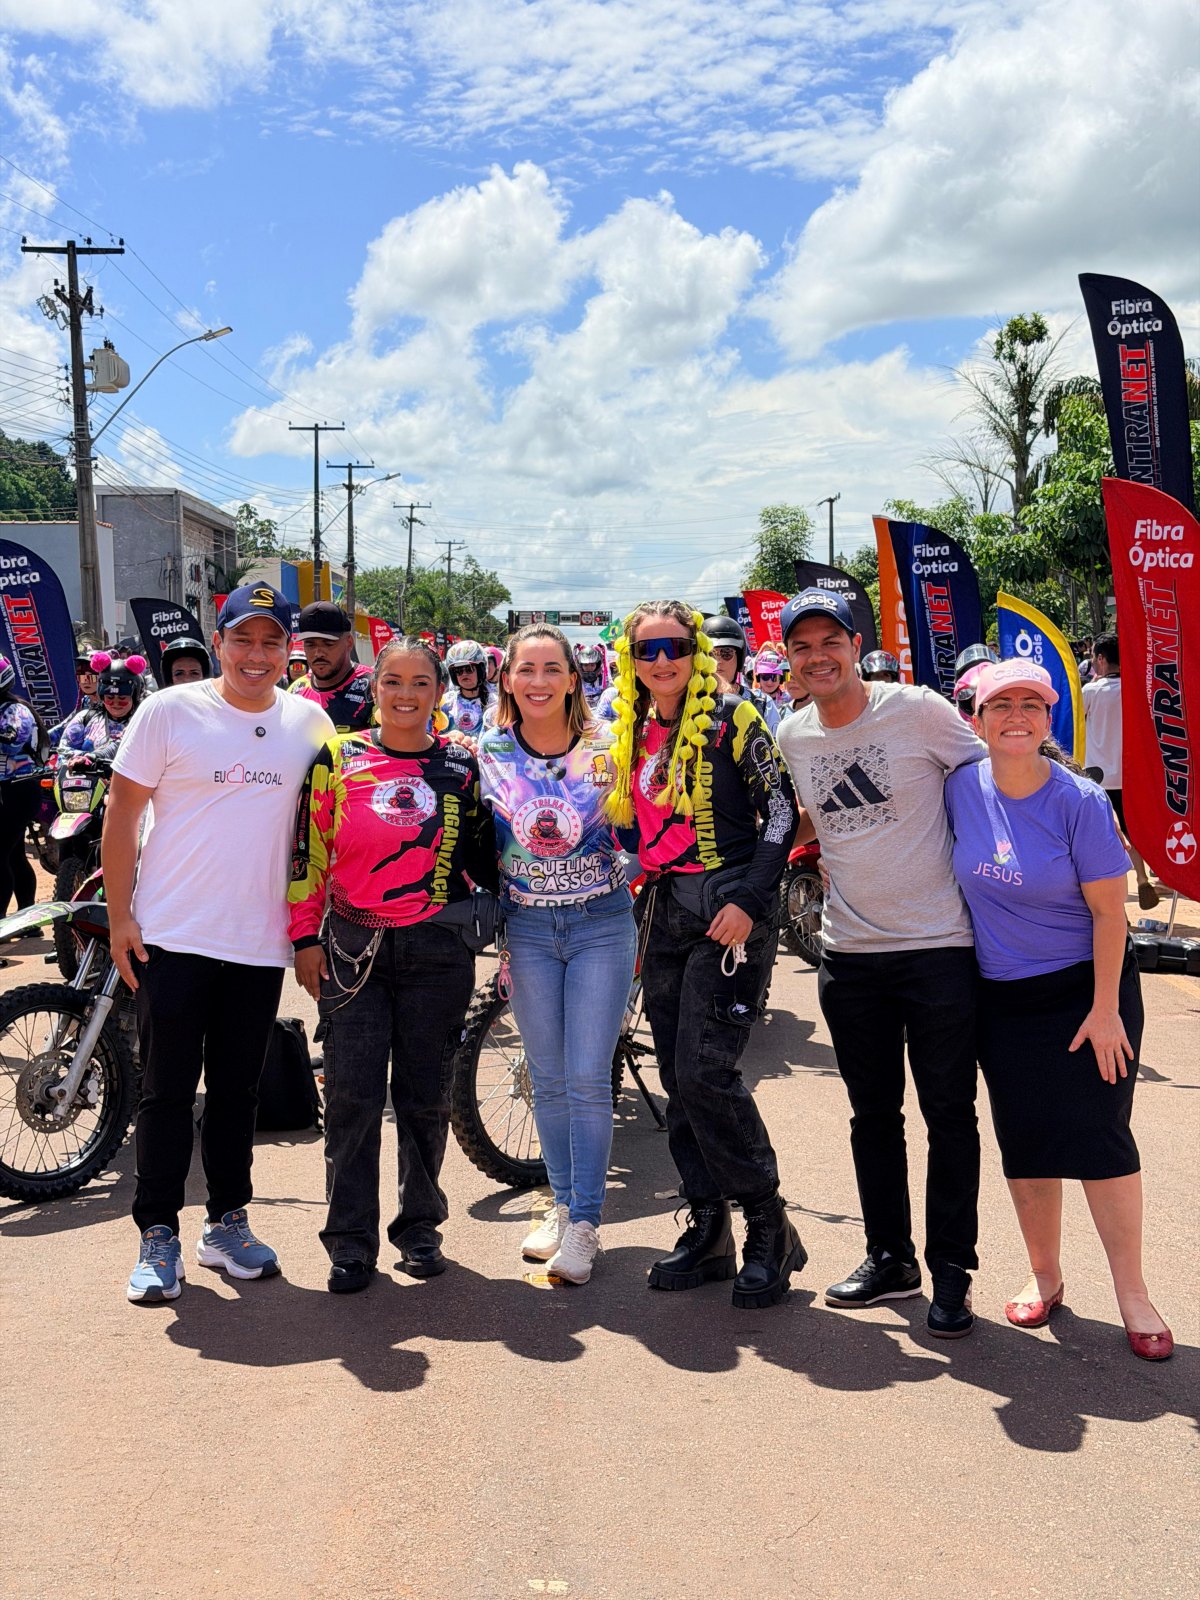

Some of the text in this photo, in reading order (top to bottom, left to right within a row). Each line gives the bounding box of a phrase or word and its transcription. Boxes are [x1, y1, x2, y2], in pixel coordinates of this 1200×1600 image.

[1111, 299, 1153, 315] Fibra
[1107, 317, 1163, 339] Óptica
[1134, 518, 1184, 541] Fibra
[913, 544, 950, 558] Fibra
[1129, 541, 1194, 573] Óptica
[912, 558, 958, 577] Óptica
[0, 570, 41, 590] ptica
[817, 578, 849, 589] Fibra
[738, 607, 749, 615] Fib
[761, 601, 786, 610] Fibra
[152, 610, 182, 623] Fibra
[737, 614, 752, 625] Ópt
[761, 610, 781, 622] Ópti
[150, 622, 189, 637] Óptica
[1144, 579, 1190, 816] CENTRANET
[214, 771, 283, 785] EU CACOAL
[532, 798, 565, 812] TRILHA
[507, 853, 602, 877] JAQUELINE
[528, 866, 605, 892] CASSOL
[972, 862, 1023, 886] JESUS
